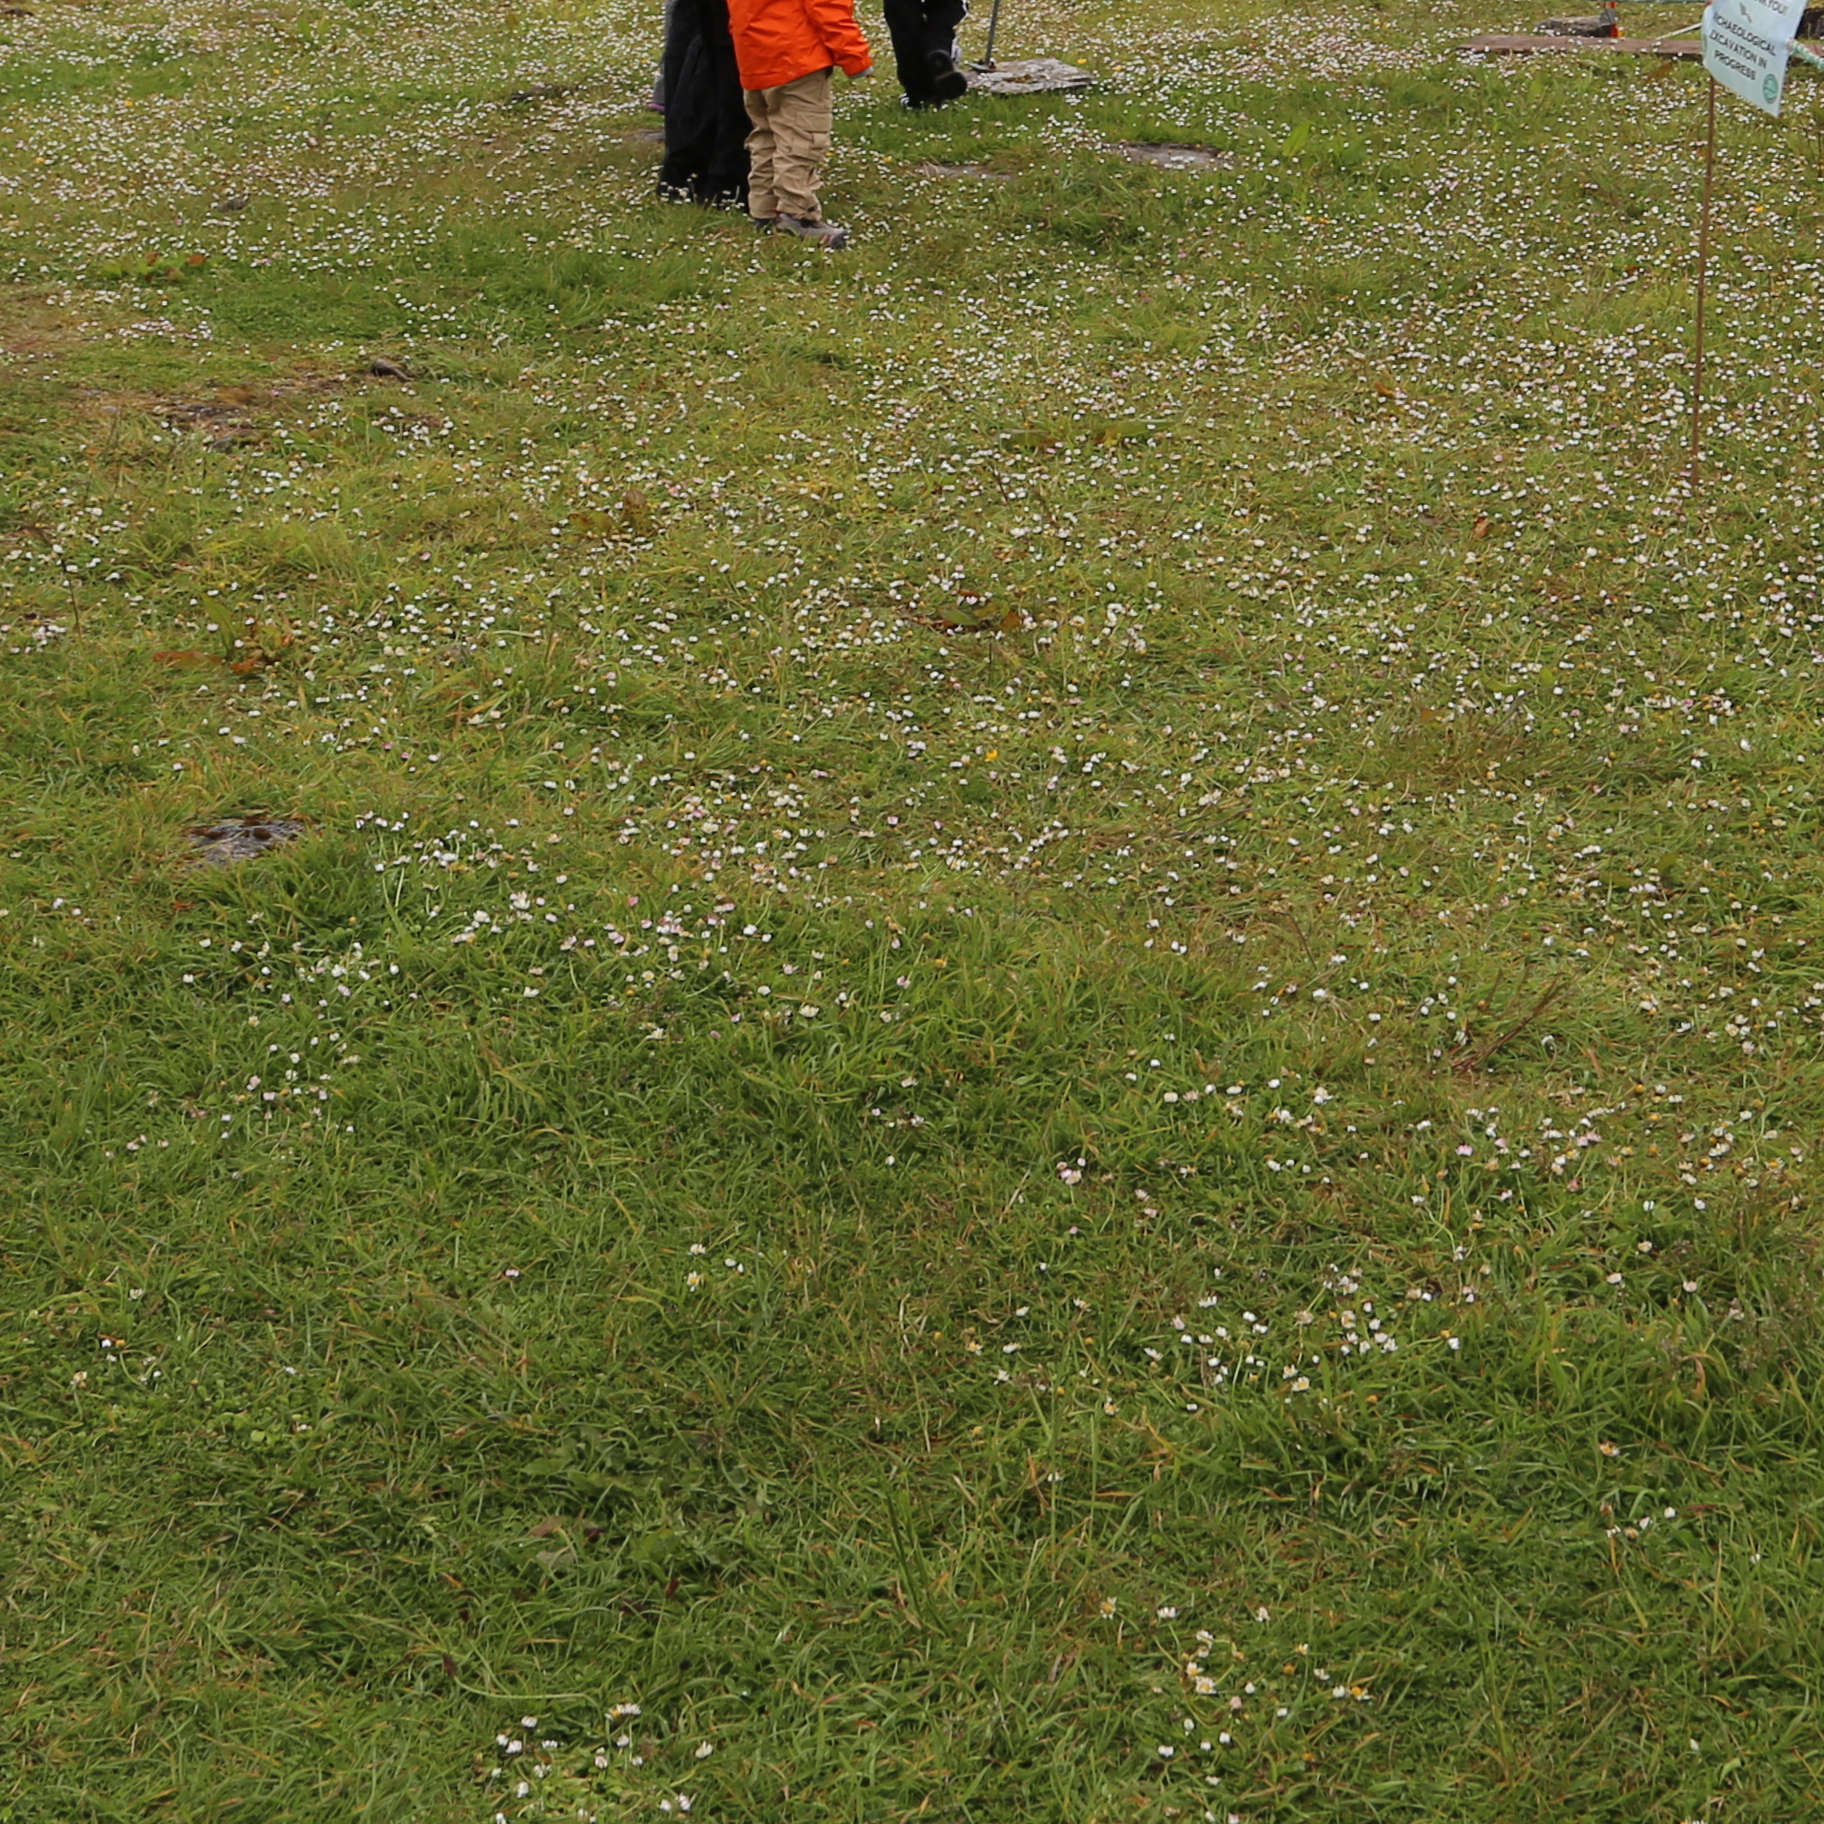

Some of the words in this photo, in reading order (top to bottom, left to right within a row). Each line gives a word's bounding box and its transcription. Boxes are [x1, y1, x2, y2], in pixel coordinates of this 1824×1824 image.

[1709, 29, 1758, 63] EXCAVATION
[1757, 56, 1768, 69] IN
[1713, 11, 1776, 56] RCHAEOLOGICAL
[1714, 49, 1756, 81] PROGRESS
